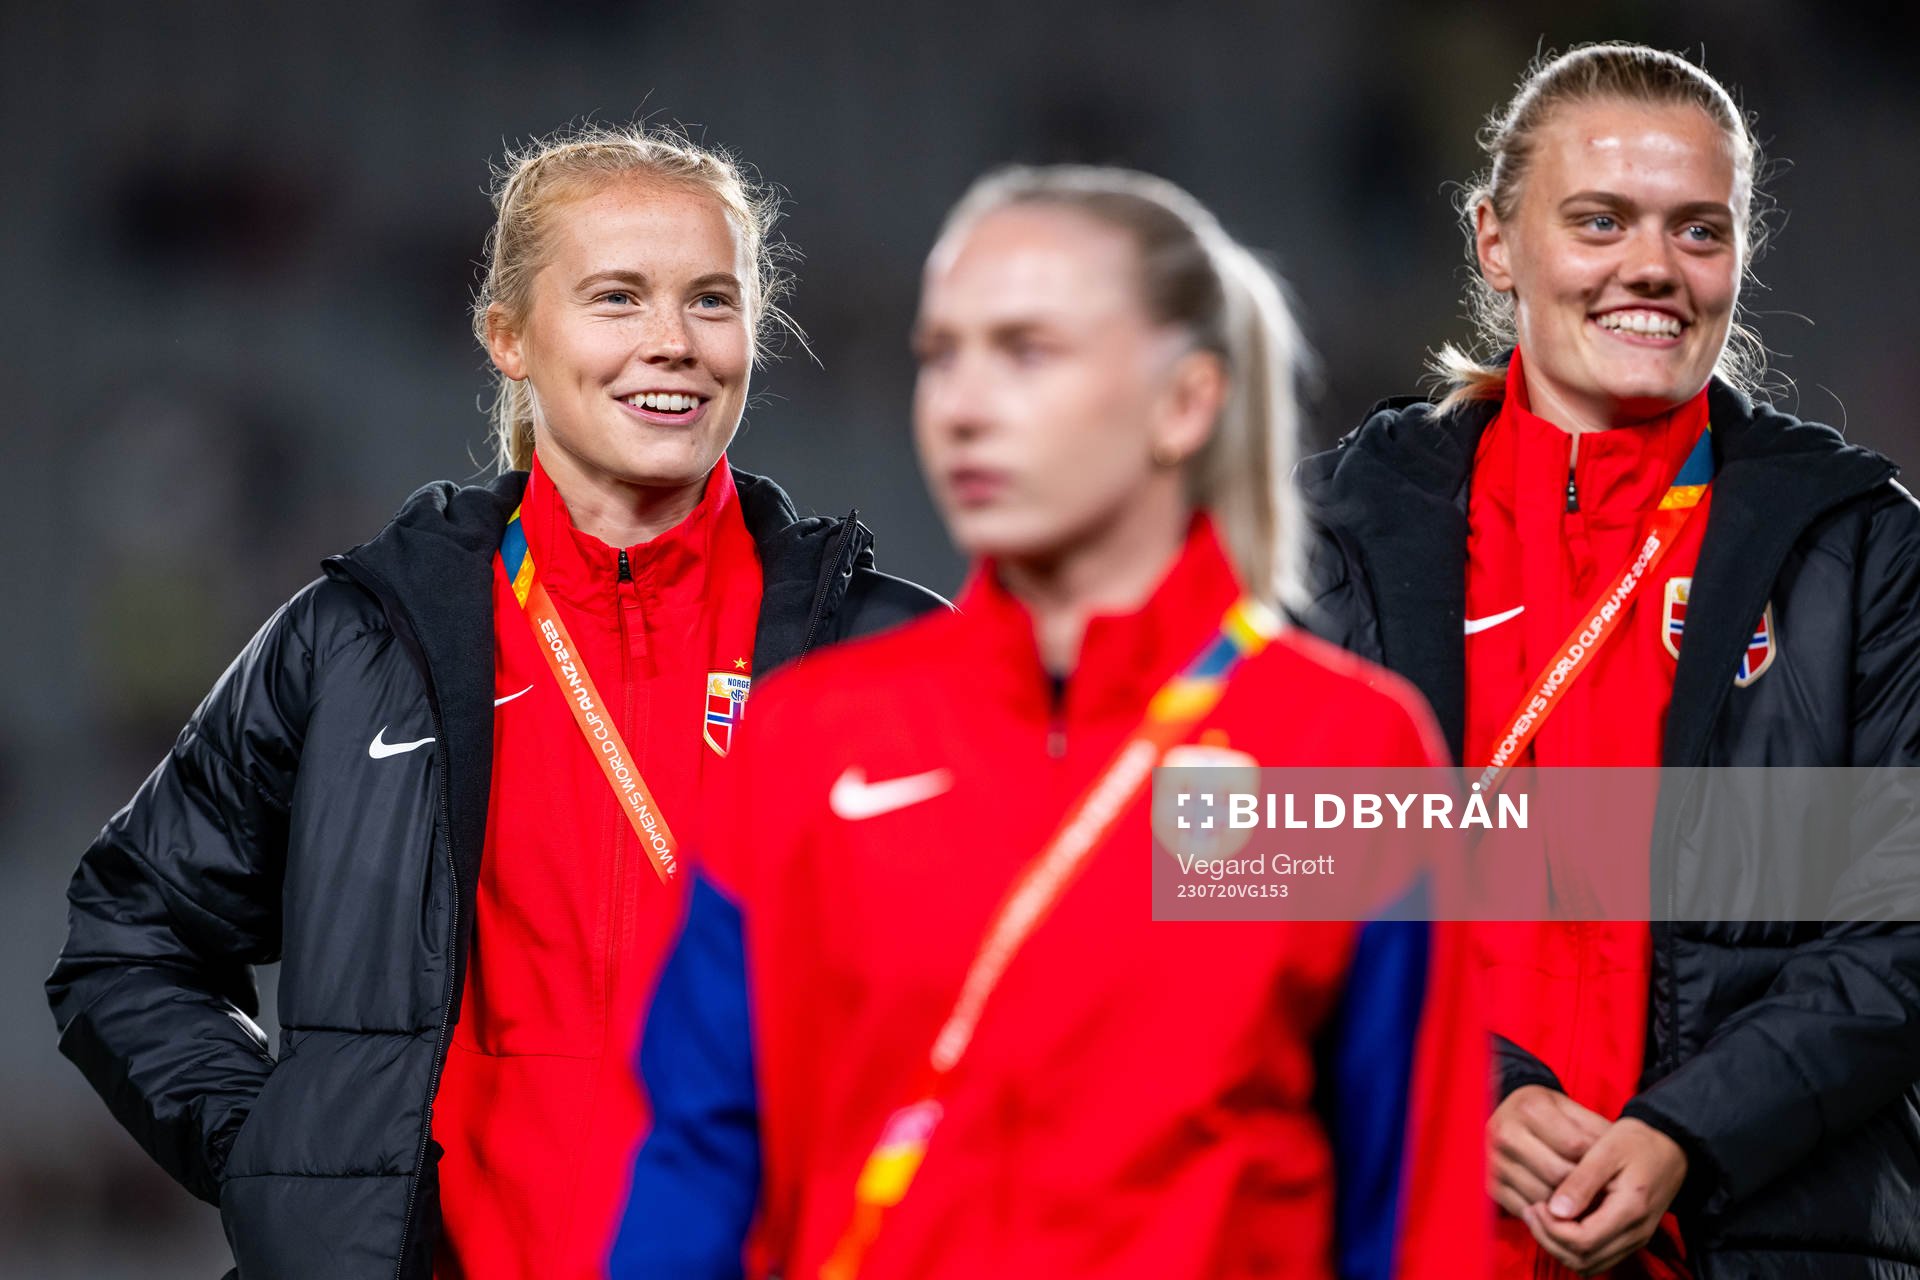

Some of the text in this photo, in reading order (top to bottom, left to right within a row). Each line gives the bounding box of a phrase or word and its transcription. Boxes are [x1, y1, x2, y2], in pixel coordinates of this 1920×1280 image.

[727, 678, 750, 689] NORGE
[1491, 694, 1547, 767] WOMEN'S
[1539, 644, 1584, 697] WORLD
[1579, 615, 1603, 648] CUP
[585, 711, 609, 740] CUP
[601, 740, 636, 790] WORLD
[628, 791, 674, 866] WOMEN'S
